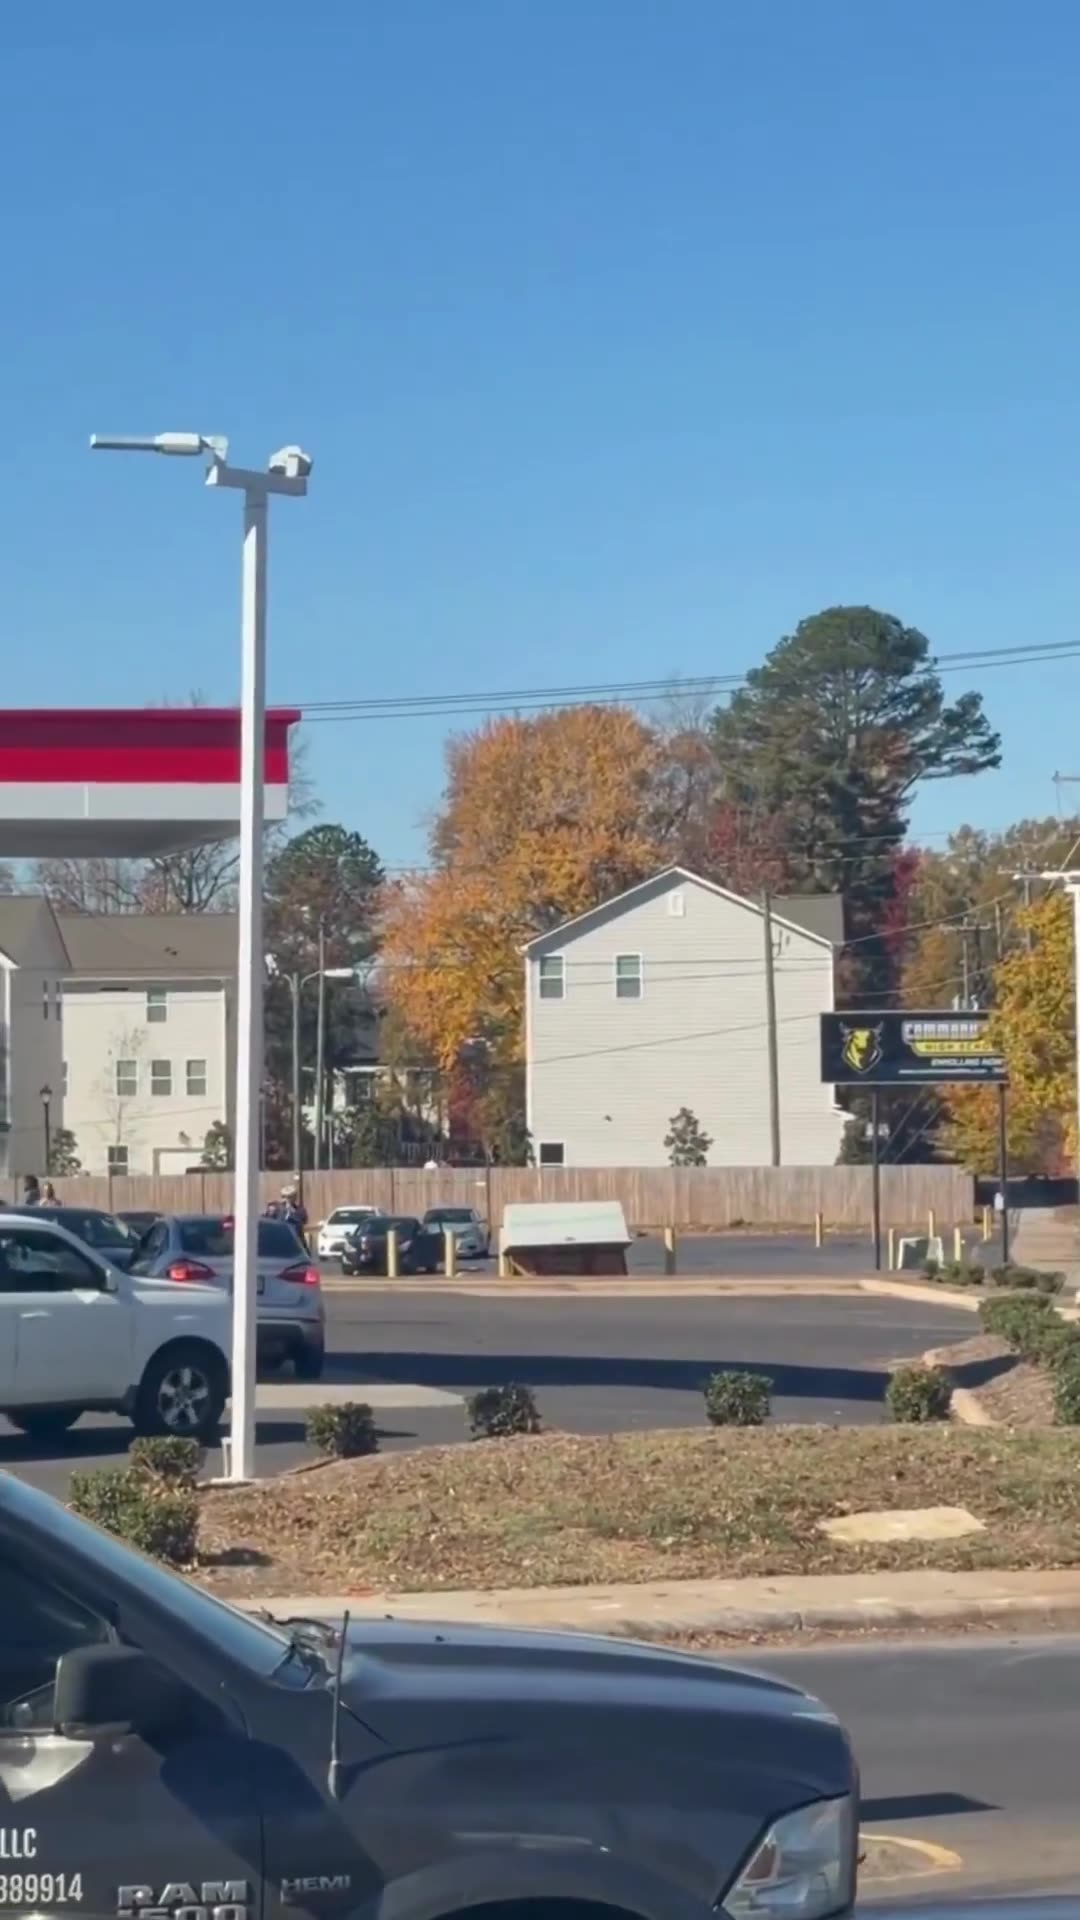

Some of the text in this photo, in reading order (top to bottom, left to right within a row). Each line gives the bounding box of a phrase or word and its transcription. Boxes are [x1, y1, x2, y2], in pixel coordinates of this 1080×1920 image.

[0, 1828, 37, 1858] LLC
[118, 1880, 247, 1906] RAM
[281, 1875, 351, 1892] HEMI
